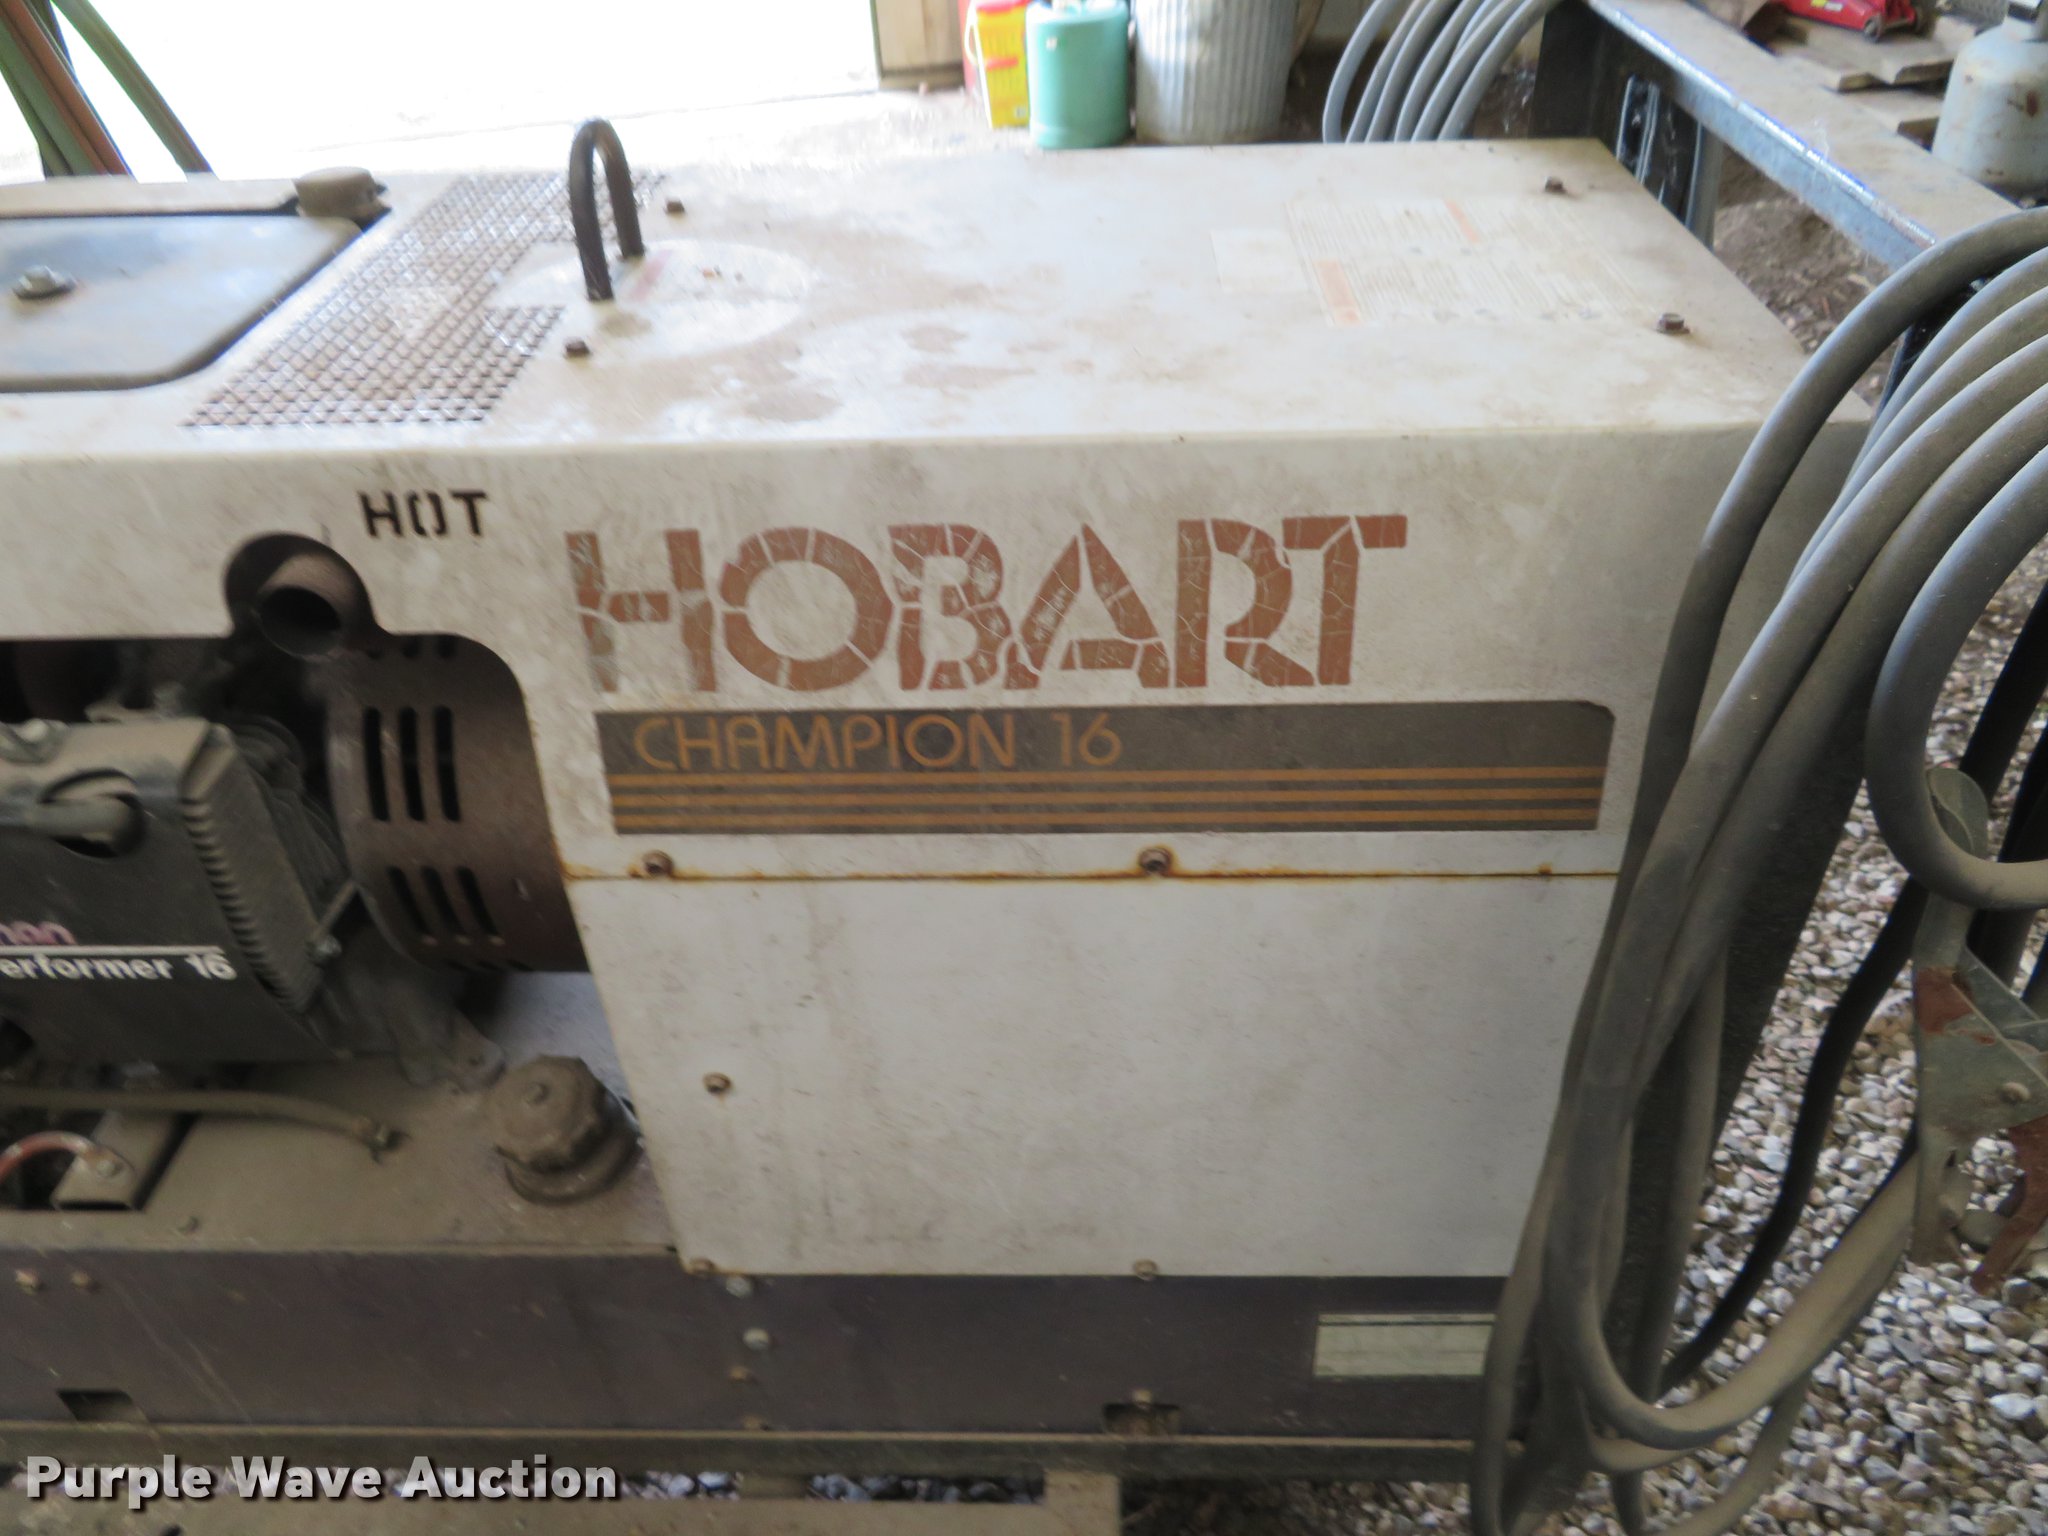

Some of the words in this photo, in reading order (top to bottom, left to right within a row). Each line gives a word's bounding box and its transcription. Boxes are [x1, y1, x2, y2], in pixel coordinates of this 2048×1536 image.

[357, 490, 487, 538] HOT
[565, 514, 1407, 691] HOBART
[634, 714, 1015, 769] CHAMPION
[1052, 711, 1122, 766] 16
[184, 955, 237, 980] 16
